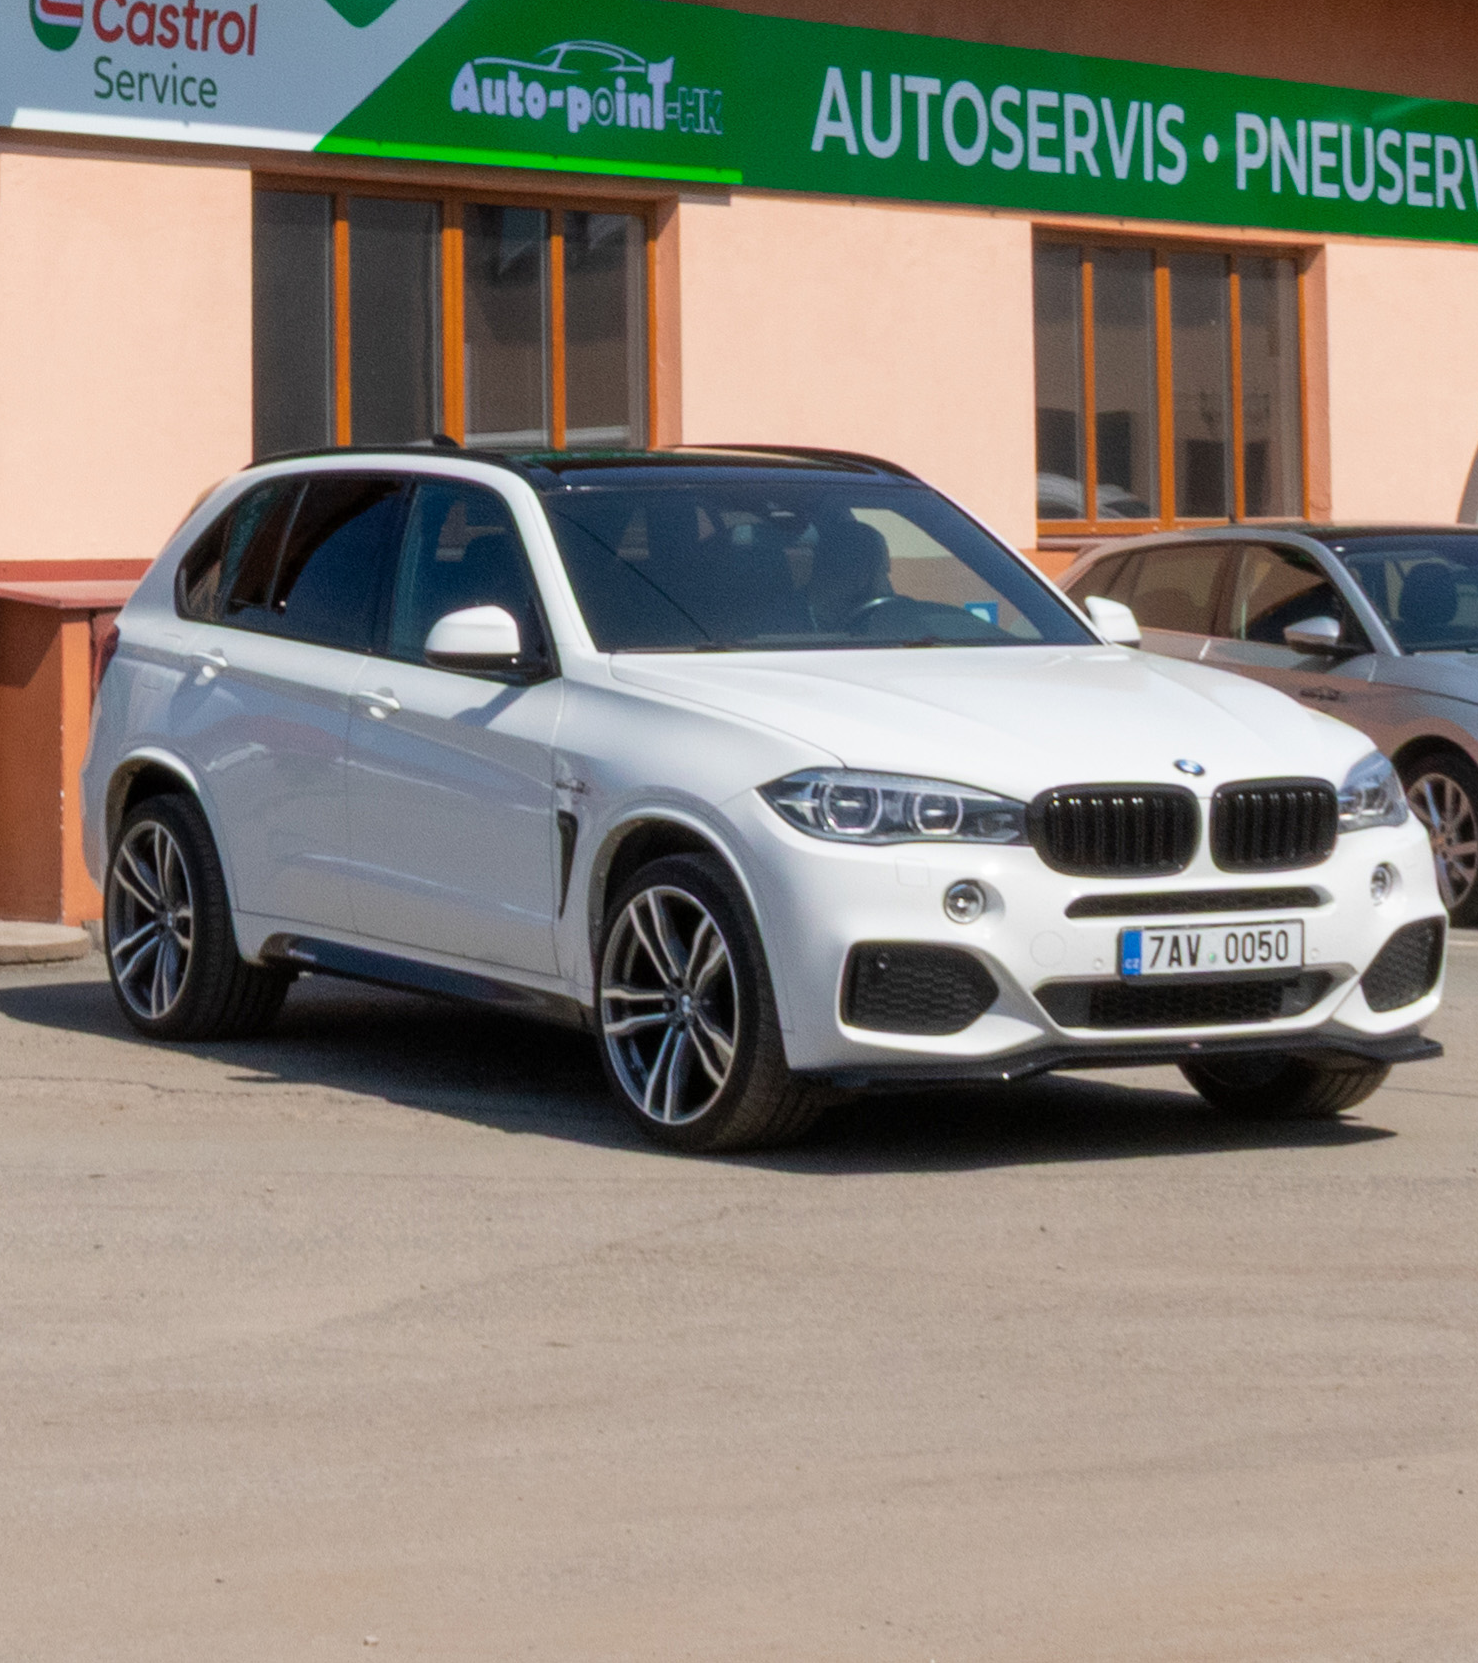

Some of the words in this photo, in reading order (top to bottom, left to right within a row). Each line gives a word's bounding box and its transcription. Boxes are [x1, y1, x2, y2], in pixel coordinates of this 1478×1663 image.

[93, 56, 218, 108] Service
[810, 66, 1188, 185] AUTOSERVIS
[1149, 934, 1201, 968] 7AV
[1224, 929, 1288, 964] 0050
